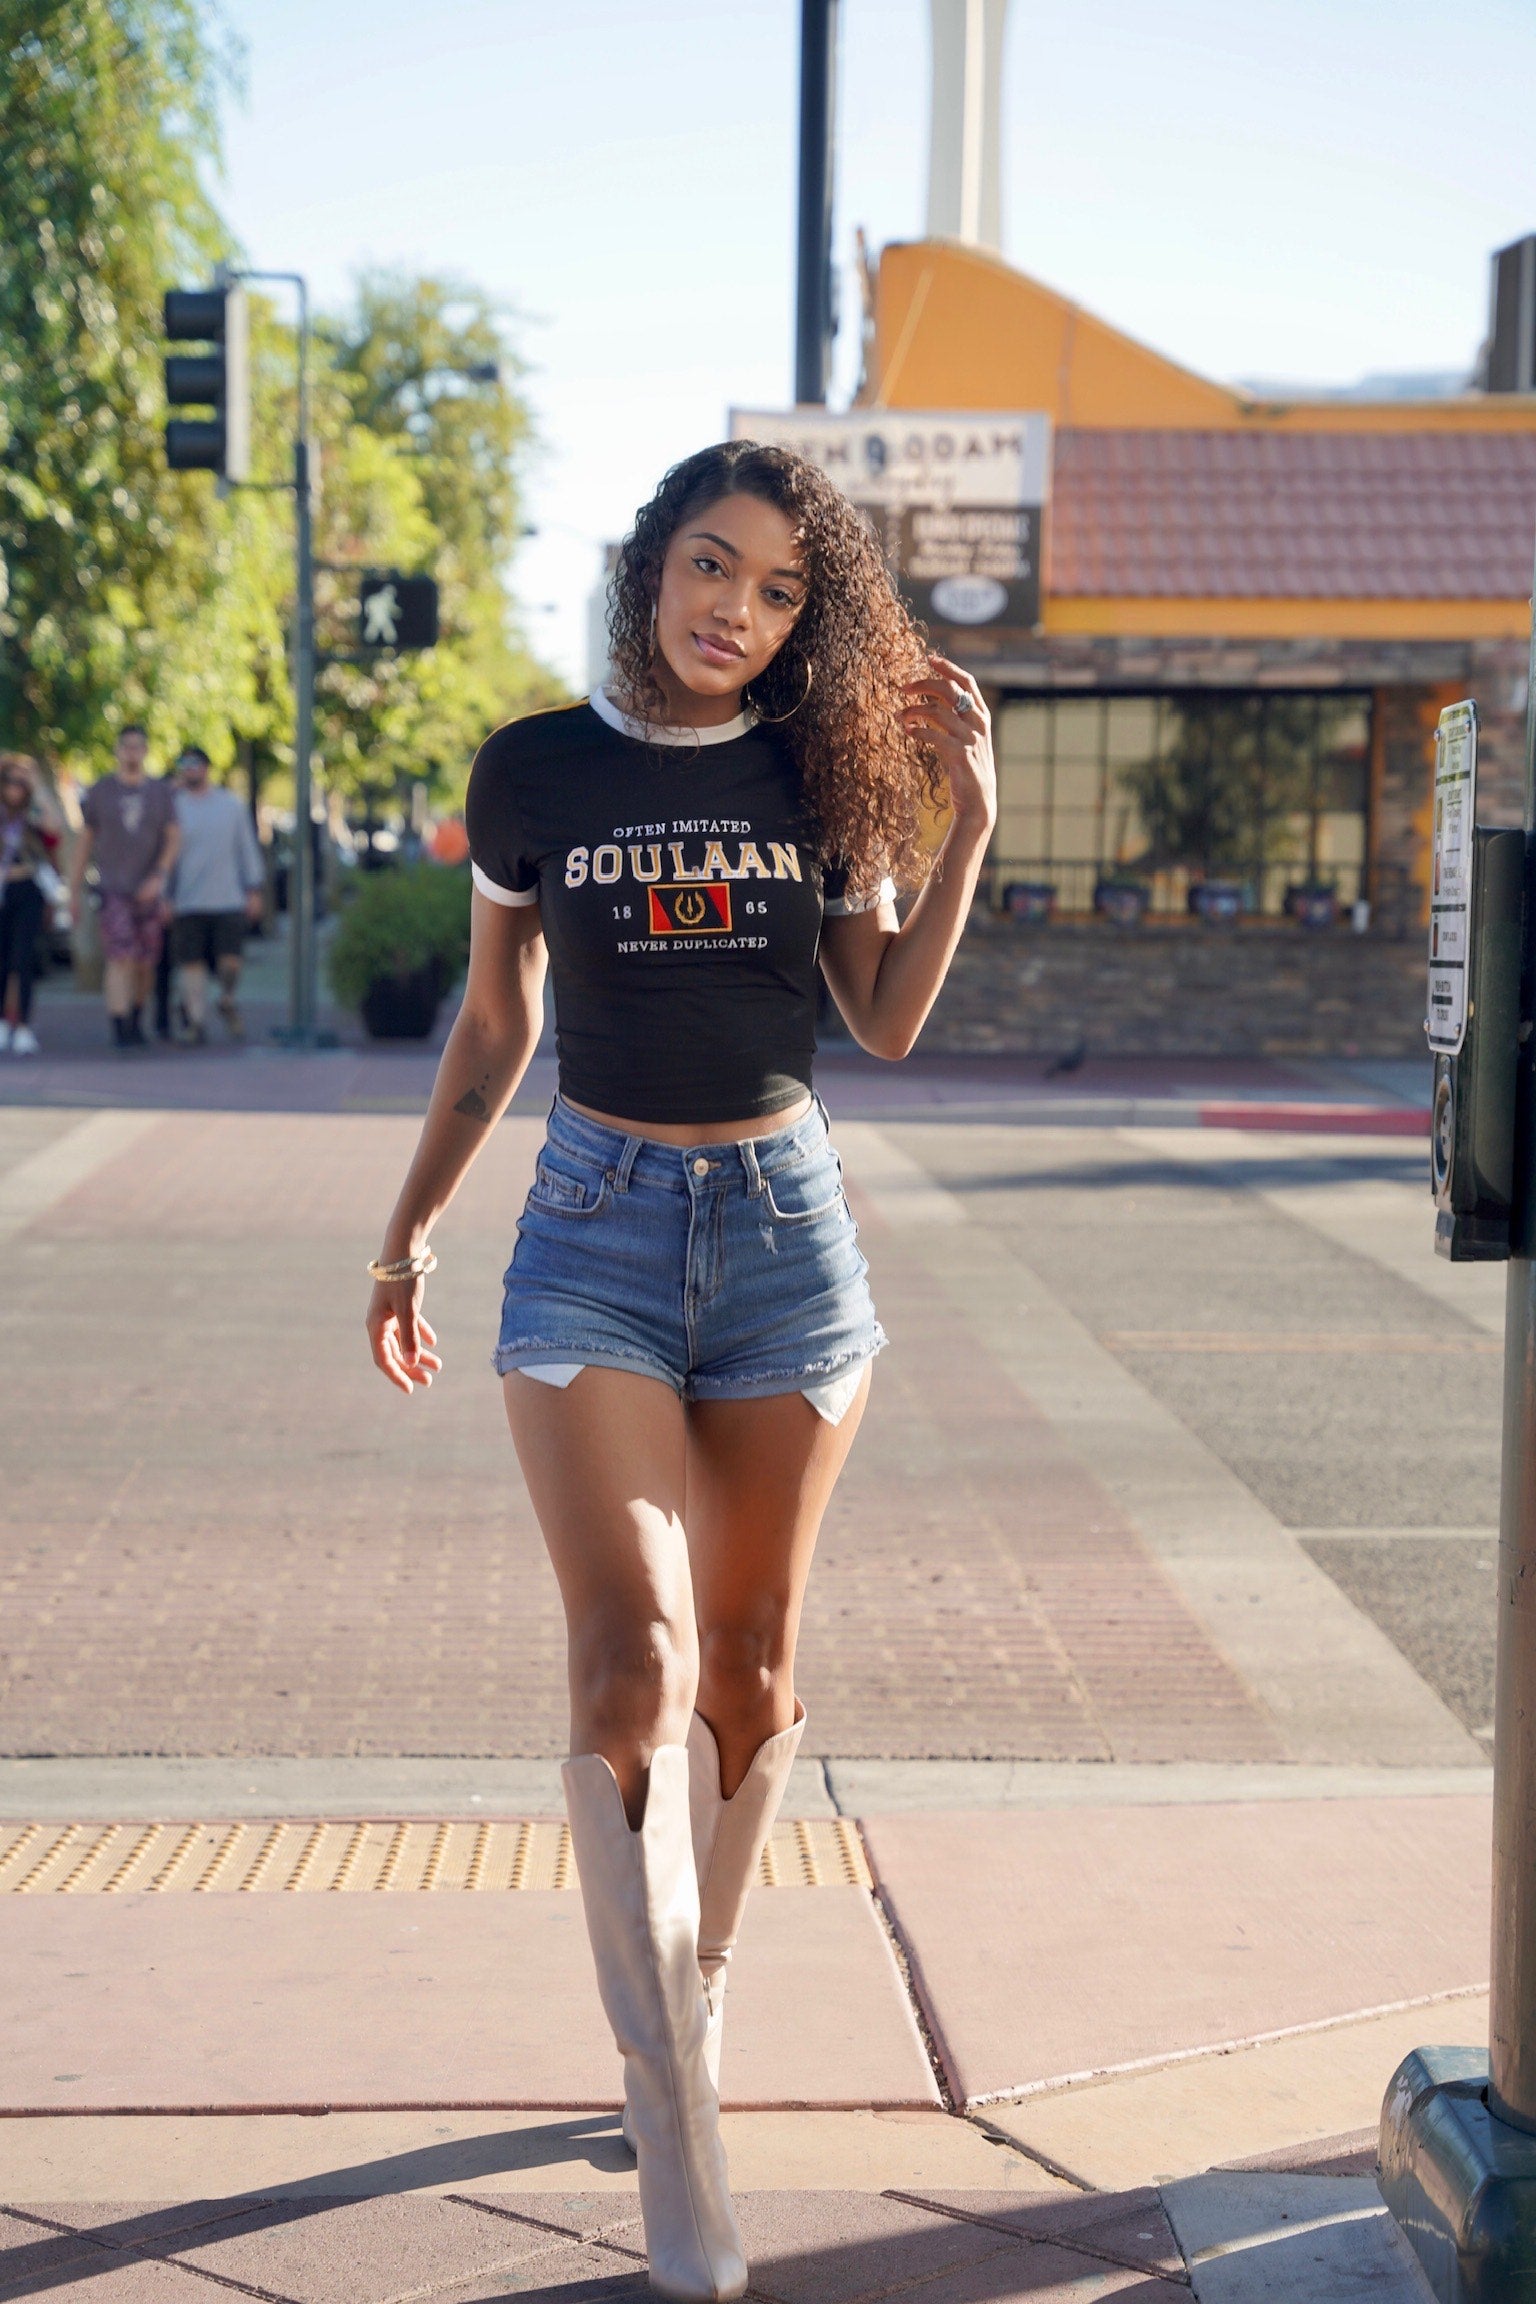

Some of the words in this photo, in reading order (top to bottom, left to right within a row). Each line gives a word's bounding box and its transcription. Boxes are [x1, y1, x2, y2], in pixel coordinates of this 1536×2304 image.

[613, 823, 665, 837] OFTEN
[673, 820, 750, 833] IMITATED
[565, 841, 802, 889] SOULAAN
[613, 906, 631, 919] 18
[618, 941, 667, 953] NEVER
[673, 937, 767, 949] DUPLICATED
